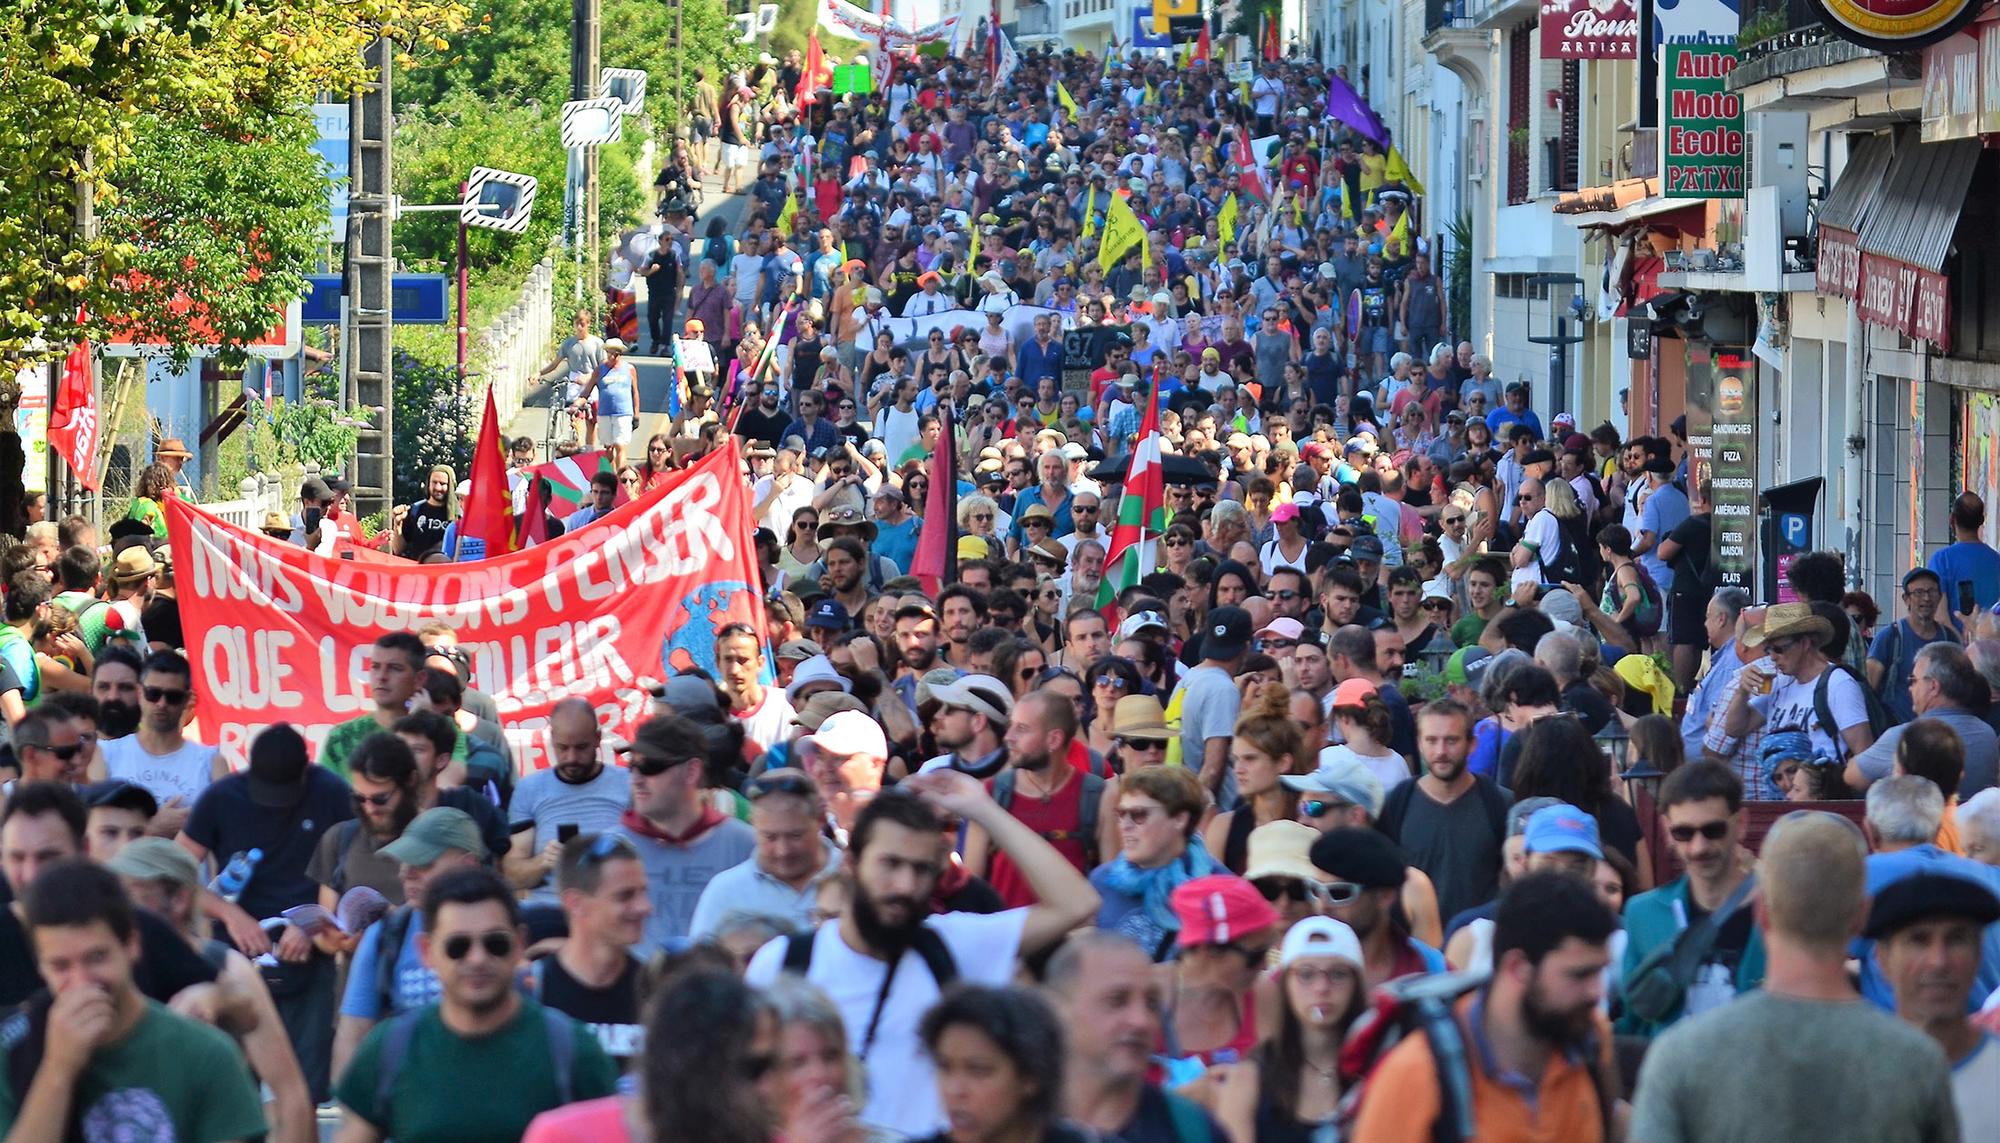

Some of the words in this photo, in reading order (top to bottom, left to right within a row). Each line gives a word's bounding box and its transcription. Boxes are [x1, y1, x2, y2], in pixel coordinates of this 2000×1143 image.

[1563, 9, 1637, 38] Roux
[1676, 50, 1738, 79] Auto
[1672, 89, 1739, 120] Moto
[1669, 125, 1743, 157] Ecole
[1713, 424, 1752, 434] SANDWICHES
[1723, 451, 1741, 461] PIZZA
[1712, 478, 1753, 488] HAMBURGERS
[1714, 503, 1750, 515] AMÉRICAINS
[1722, 532, 1742, 542] FRITES
[1788, 516, 1804, 540] P
[191, 516, 304, 614] NOUS
[307, 556, 530, 630] VOULONS
[542, 471, 735, 612] PENSER
[1721, 546, 1743, 556] MAISON
[1722, 573, 1741, 583] PLATS
[203, 625, 304, 710] QUE
